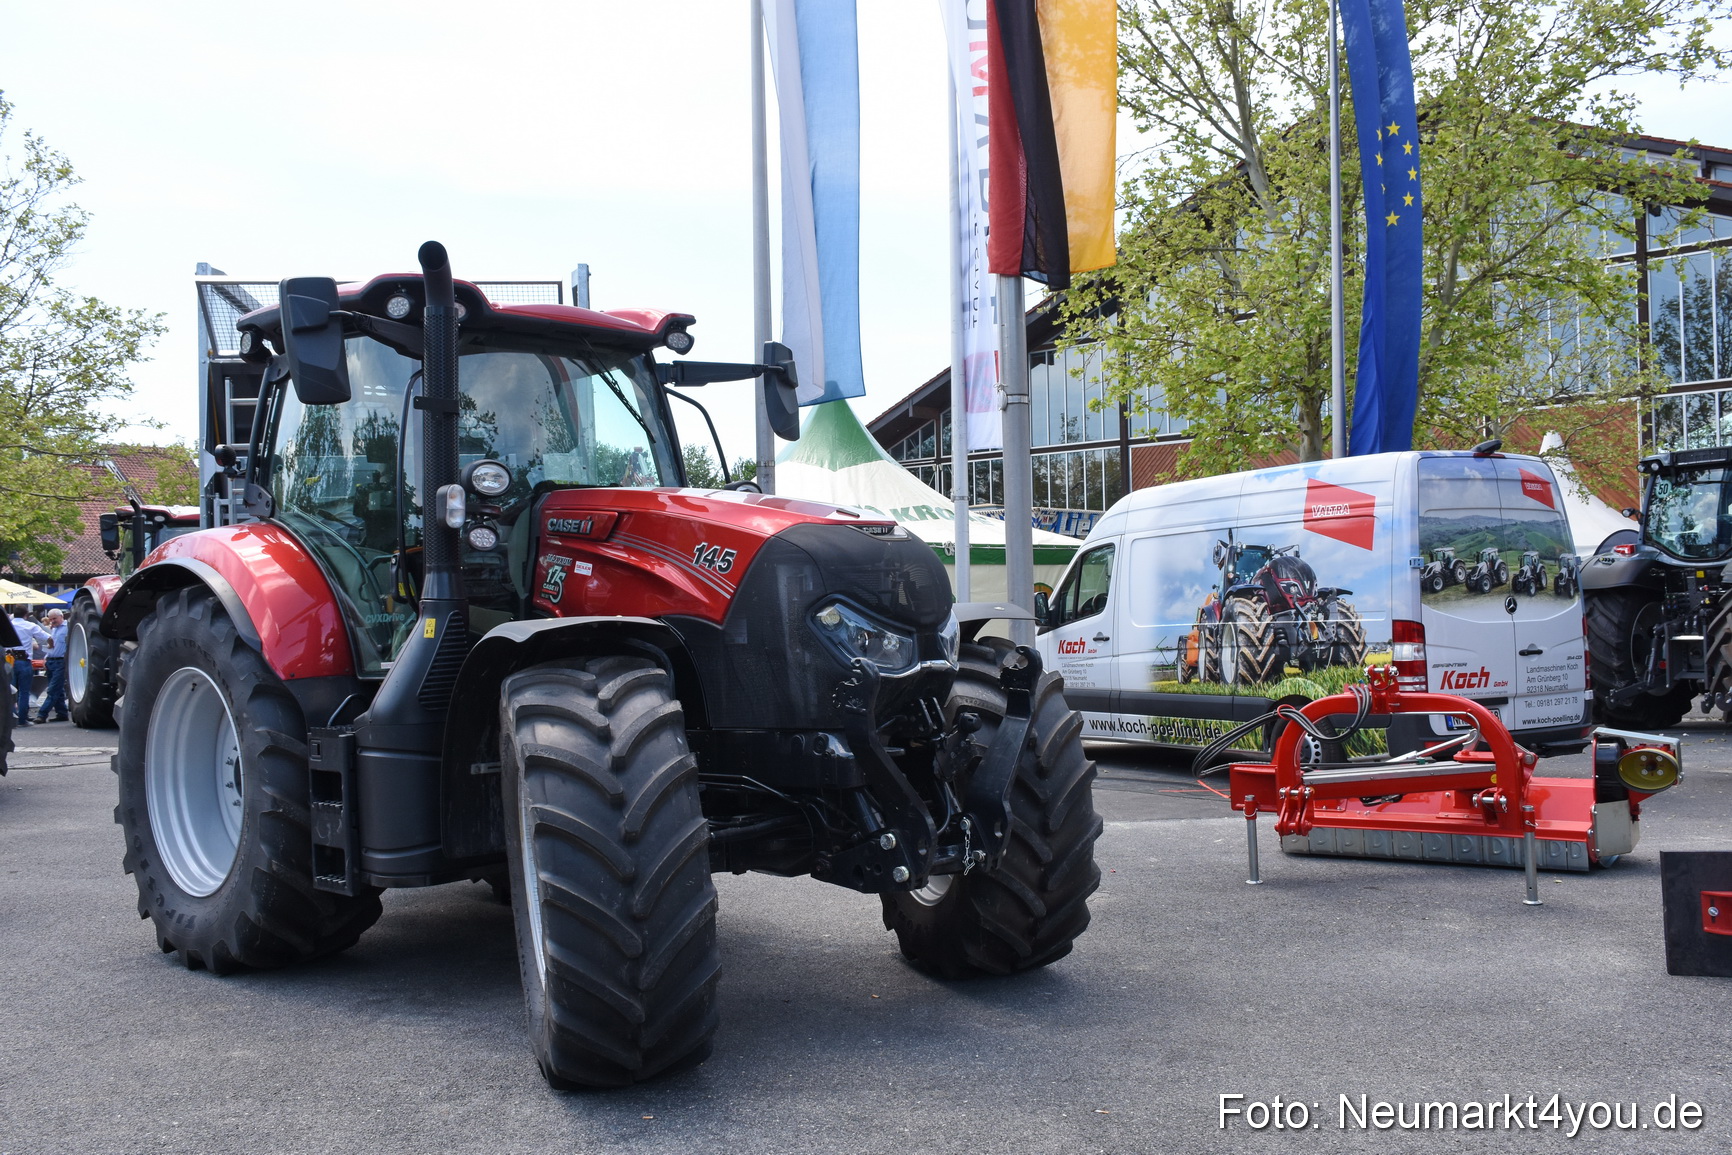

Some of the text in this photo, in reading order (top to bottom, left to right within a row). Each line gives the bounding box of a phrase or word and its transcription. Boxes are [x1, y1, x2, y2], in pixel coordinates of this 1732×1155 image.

[1658, 483, 1669, 495] 50
[1312, 504, 1350, 518] VALTRA
[692, 541, 738, 574] 145
[365, 612, 405, 624] CVXDrive
[1058, 637, 1085, 654] Koch
[1526, 664, 1566, 673] Landmaschinen
[1440, 666, 1490, 690] Koch
[1537, 674, 1561, 682] Grünberg
[1527, 683, 1568, 693] 92318 Neumarkt
[1524, 700, 1536, 708] Tel.:
[1537, 699, 1552, 707] 09181
[1554, 697, 1563, 706] 297
[1572, 696, 1578, 704] 78
[1522, 713, 1580, 725] www.koch-poelling.de
[1089, 717, 1221, 742] www.koch-poelling.de
